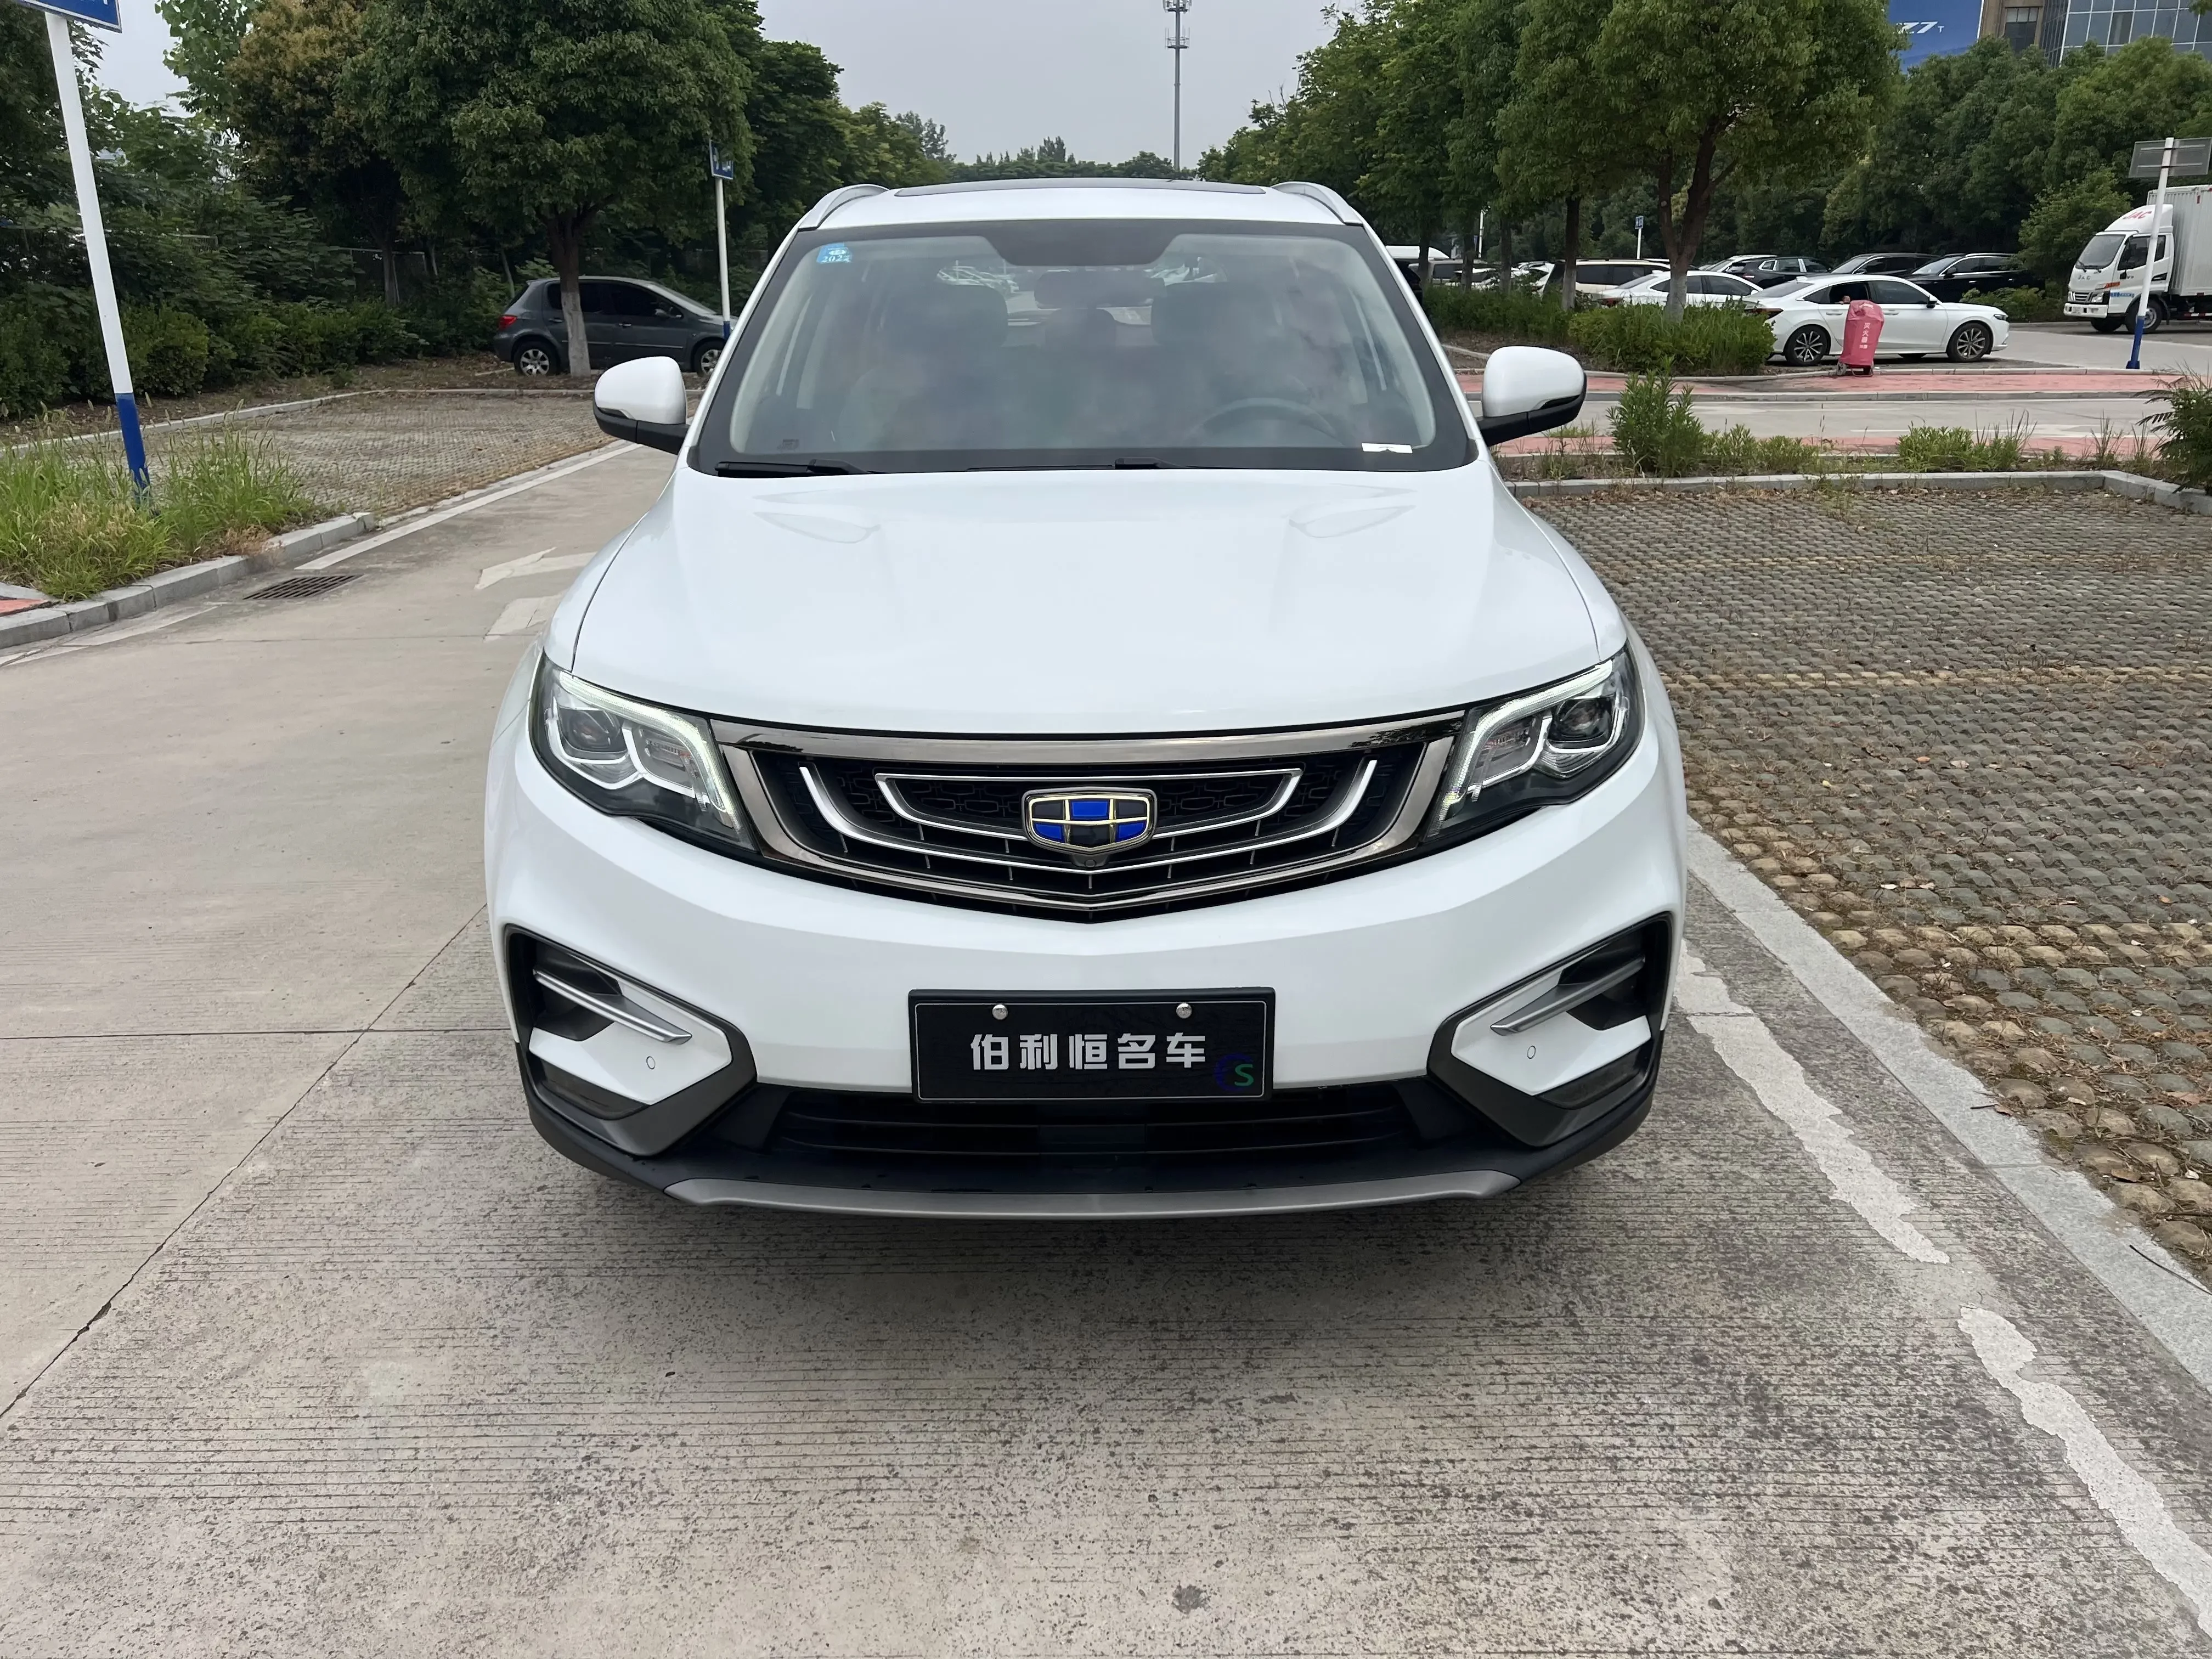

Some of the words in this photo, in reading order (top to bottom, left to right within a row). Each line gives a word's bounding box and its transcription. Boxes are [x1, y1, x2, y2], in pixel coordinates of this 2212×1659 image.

[969, 1032, 1206, 1070] 伯利恒名车
